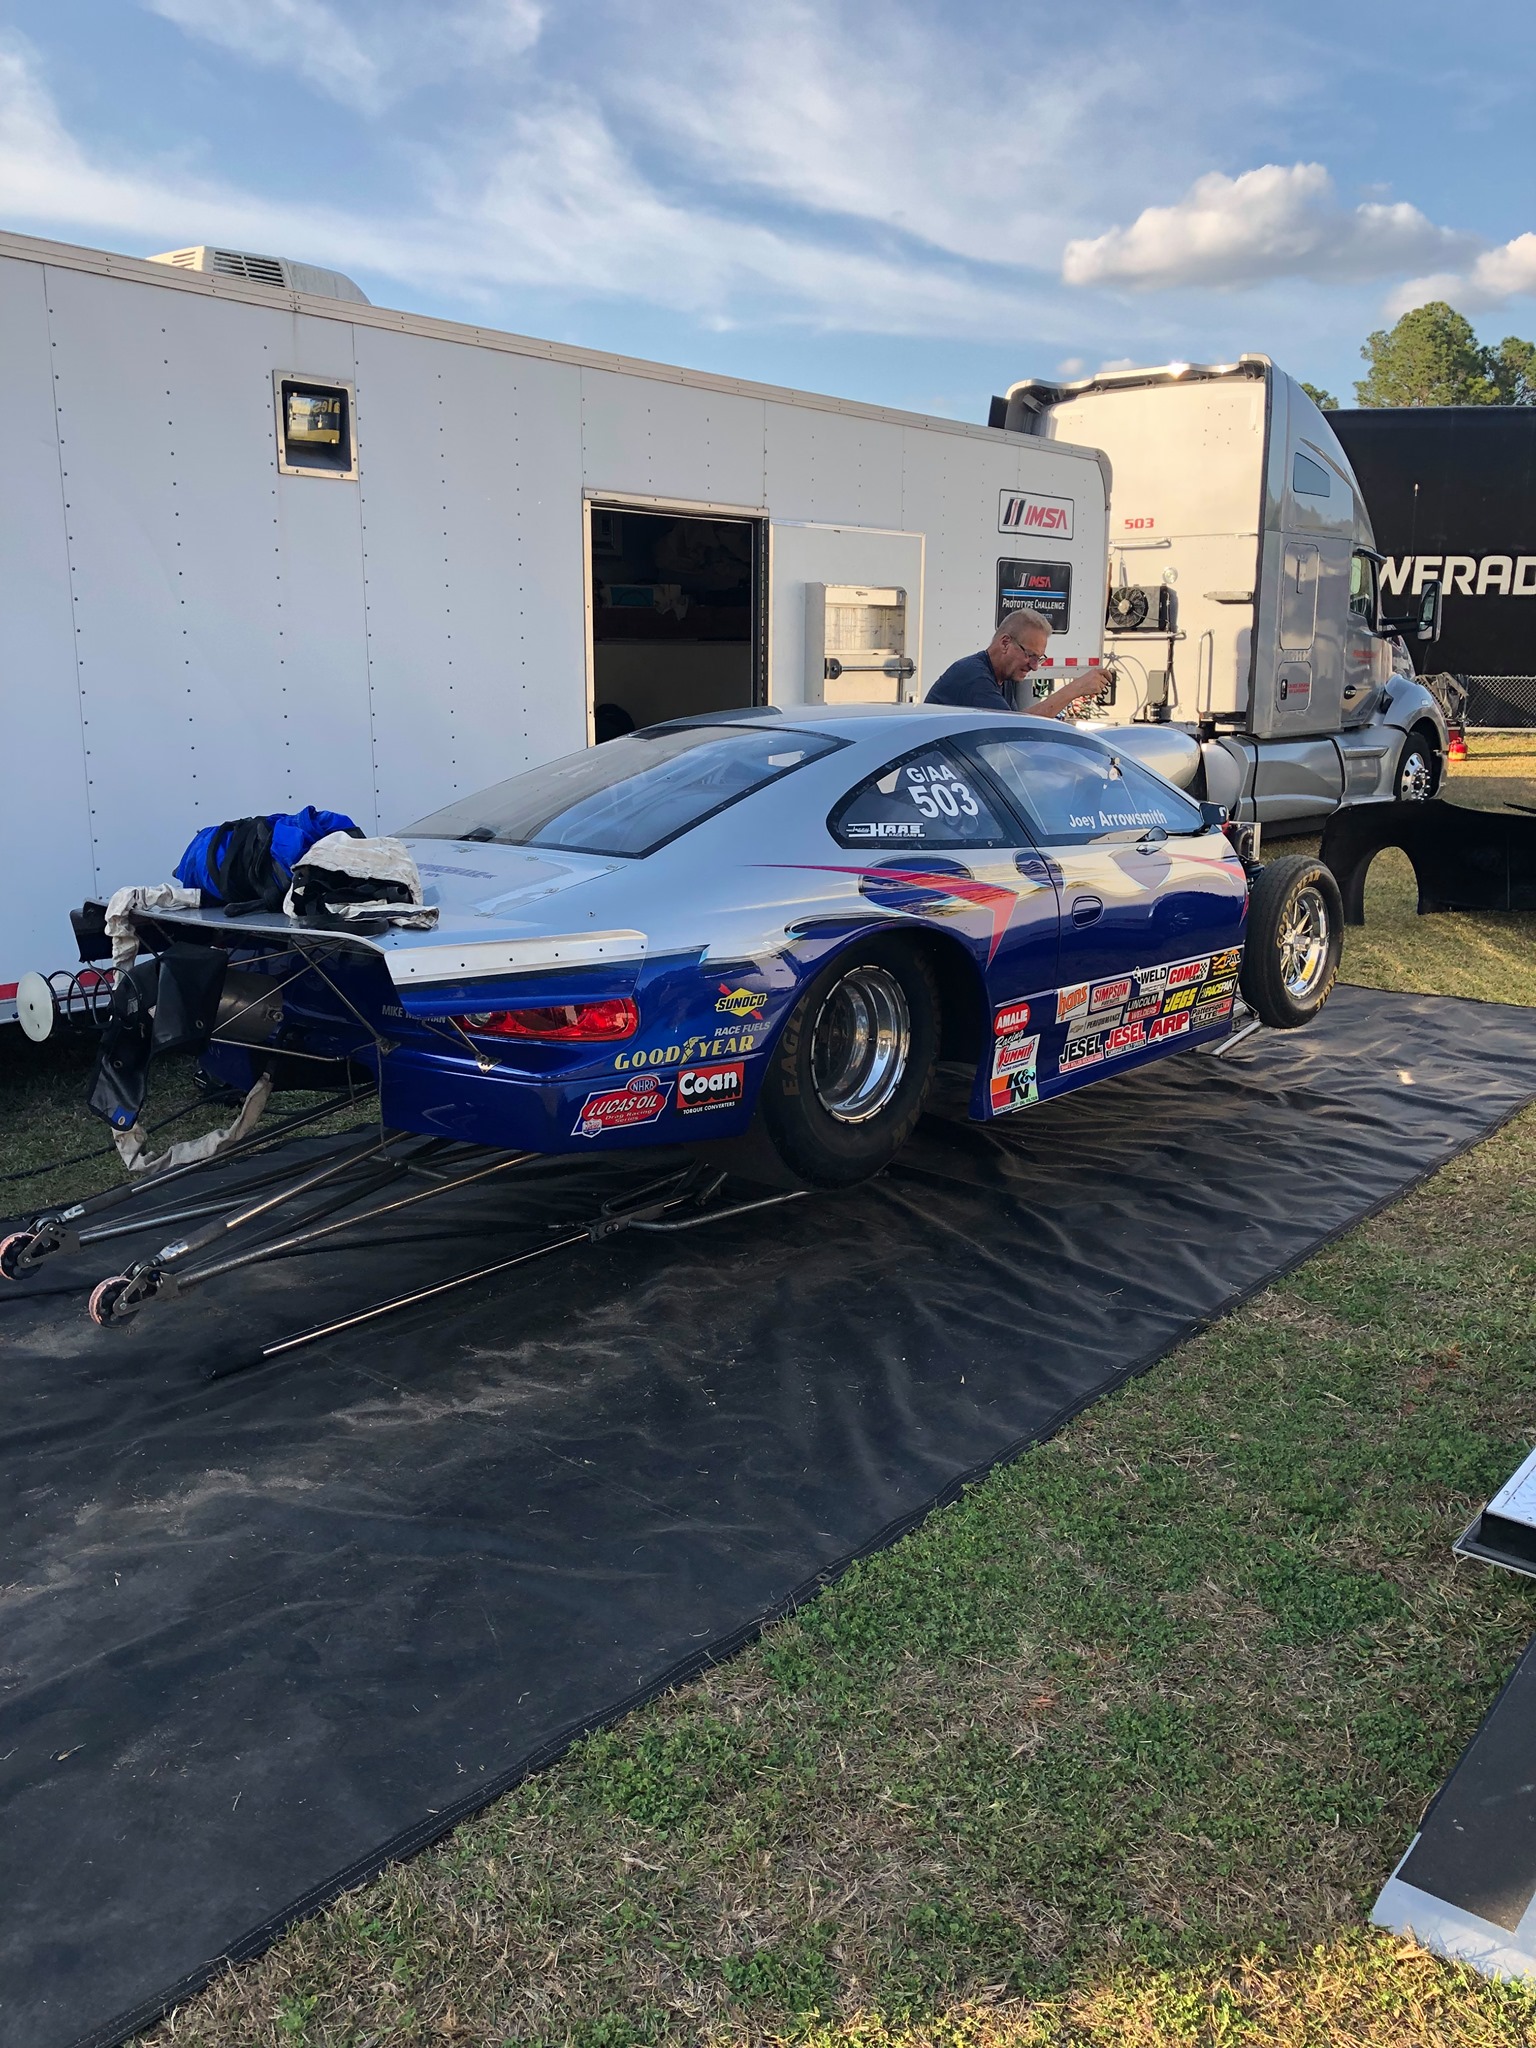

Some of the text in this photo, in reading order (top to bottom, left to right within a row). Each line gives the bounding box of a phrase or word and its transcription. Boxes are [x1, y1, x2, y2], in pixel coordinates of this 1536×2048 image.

[1024, 505, 1068, 530] IMSA
[1124, 517, 1155, 530] 503
[1028, 575, 1052, 588] IMSA
[1034, 599, 1065, 610] CHALLENGE
[907, 782, 979, 818] 503
[1069, 809, 1168, 829] Joey Arrowsmith
[870, 823, 921, 837] HAAS
[1140, 967, 1167, 985] WELD
[1169, 963, 1201, 985] COMP
[717, 995, 765, 1011] SUNOCO
[1058, 985, 1088, 1021] hans
[1094, 982, 1129, 1004] SIMPSON
[1127, 993, 1159, 1011] LINCOLN
[1163, 987, 1198, 1013] JEGS
[381, 1004, 403, 1018] MIKE
[996, 1009, 1028, 1029] AMALIE
[714, 1021, 771, 1037] RACE FUELS
[1105, 1021, 1146, 1050] JESEL
[1150, 1012, 1189, 1040] ARP
[995, 1030, 1024, 1049] Racing
[1059, 1035, 1102, 1064] JESEL
[998, 1041, 1034, 1069] SUMMIT
[632, 1080, 654, 1092] NHRA
[679, 1071, 737, 1096] Coan
[587, 1094, 658, 1117] LUCAS OIL
[683, 1101, 735, 1115] TORQUE CONVERTERS
